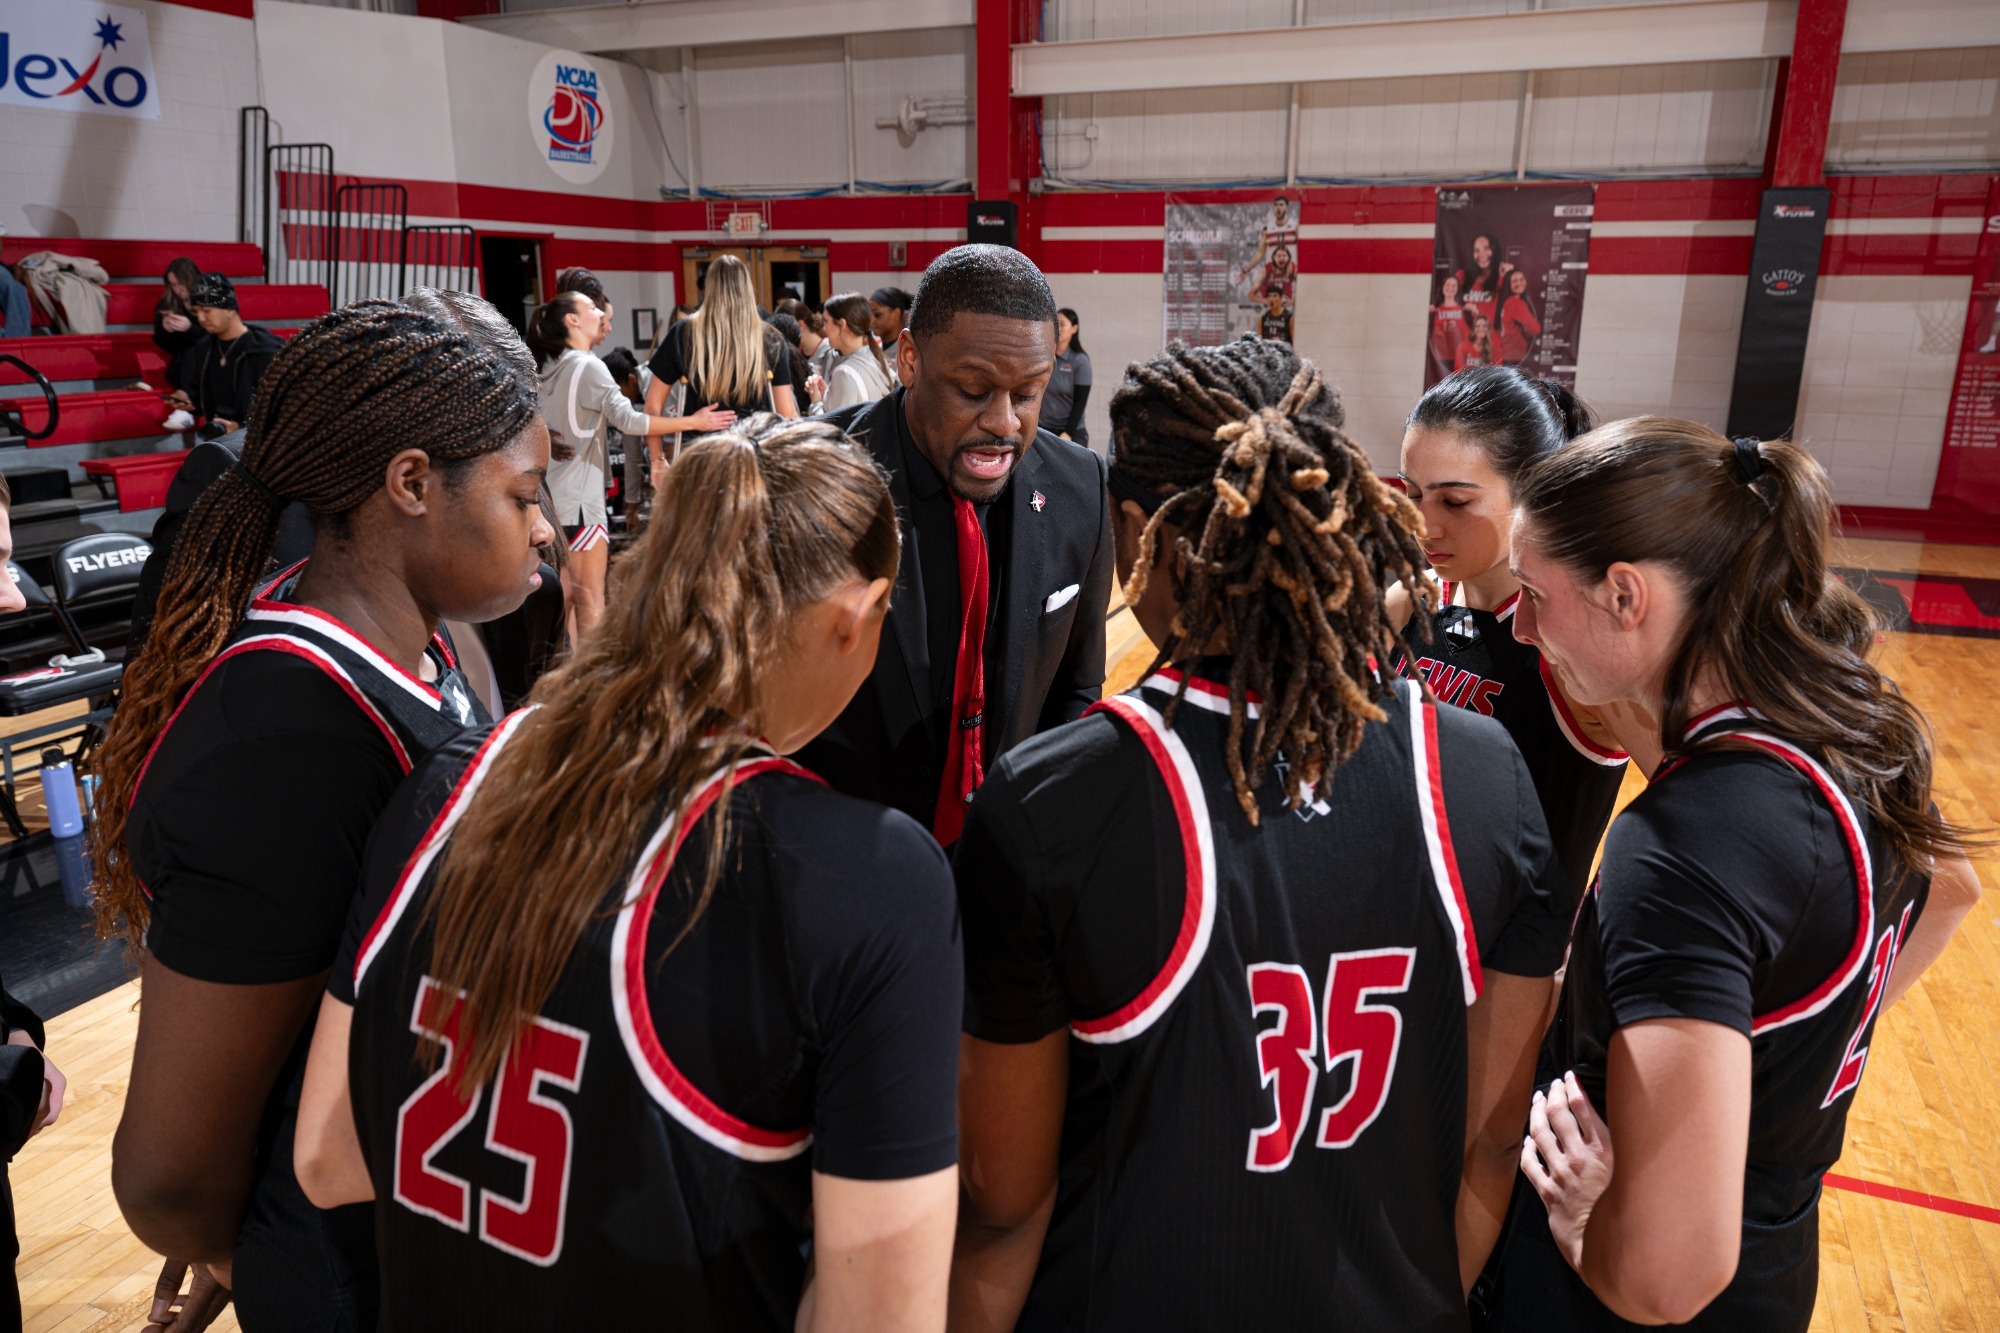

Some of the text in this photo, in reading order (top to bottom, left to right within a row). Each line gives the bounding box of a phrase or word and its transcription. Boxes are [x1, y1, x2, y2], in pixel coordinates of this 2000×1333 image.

[0, 33, 147, 108] exo
[556, 64, 598, 90] NCAA
[735, 215, 753, 232] EXIT
[1762, 269, 1805, 284] GATTO'S
[66, 545, 151, 573] FLYERS
[1246, 947, 1416, 1173] 35
[393, 974, 590, 1267] 25
